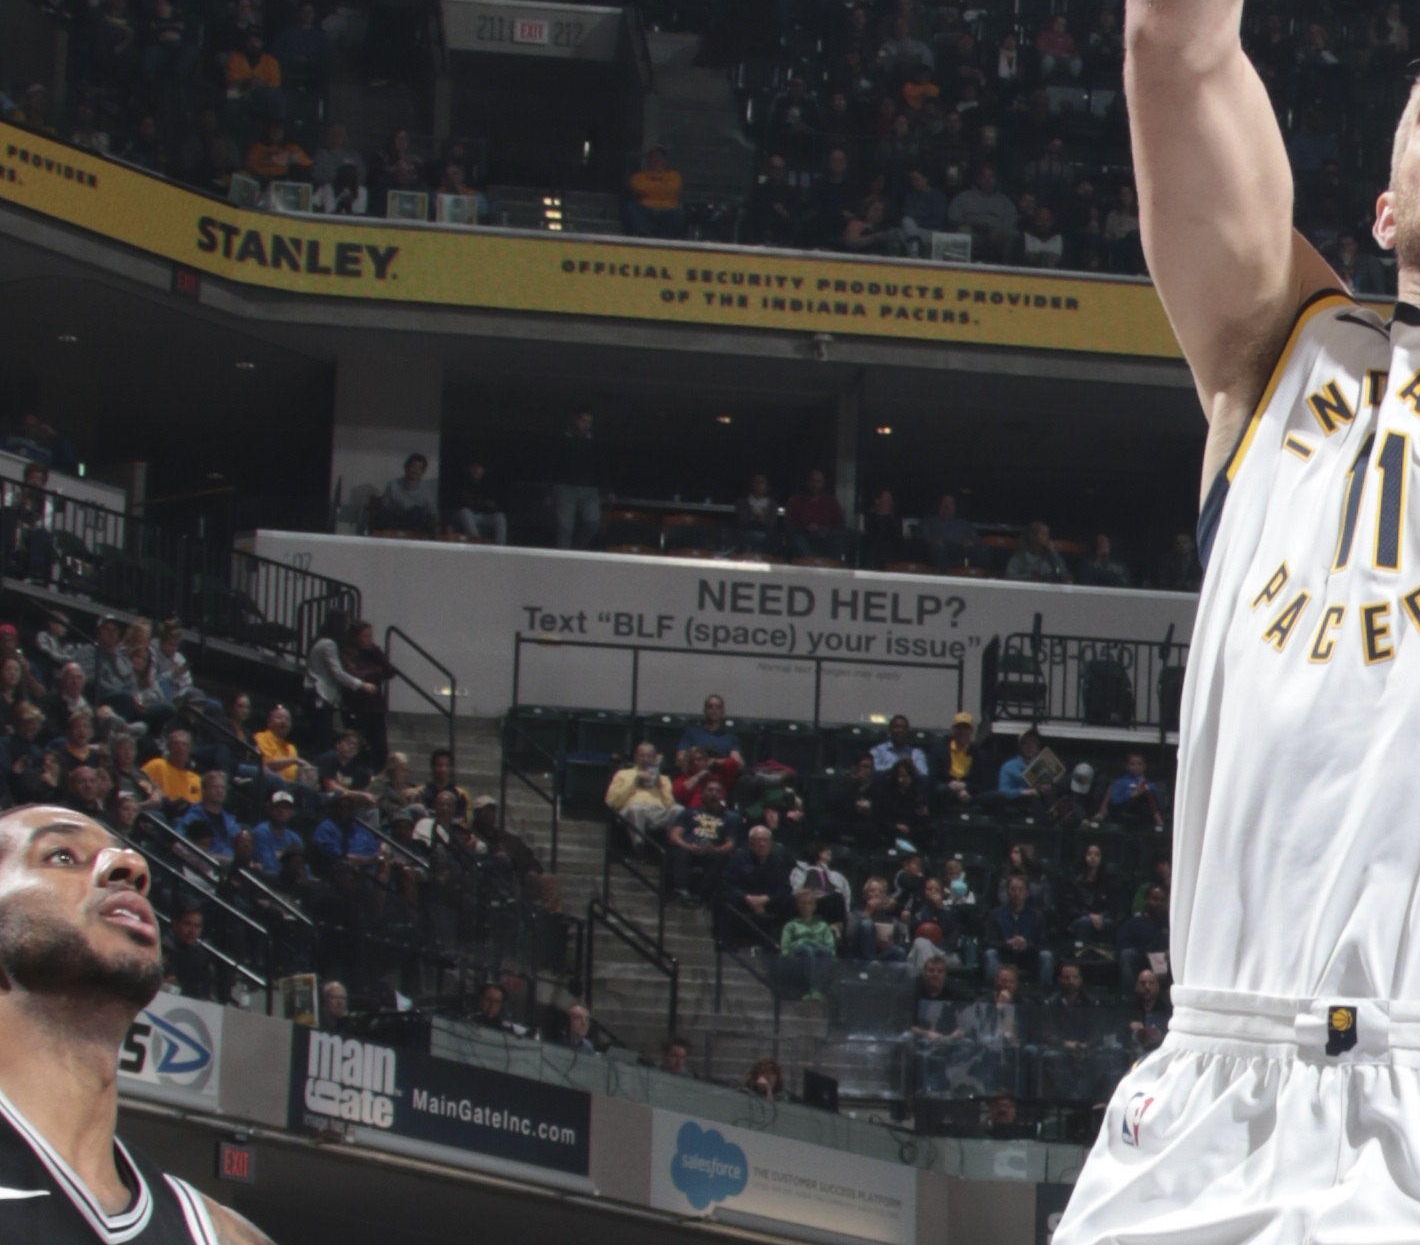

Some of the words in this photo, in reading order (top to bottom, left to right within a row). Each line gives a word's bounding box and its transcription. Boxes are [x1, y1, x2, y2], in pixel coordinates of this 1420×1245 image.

[476, 14, 505, 43] 211
[519, 20, 544, 40] EXIT
[553, 21, 584, 48] 212
[7, 143, 98, 190] PROVIDER
[561, 259, 673, 280] OFFICIAL
[685, 267, 804, 290] SECURITY
[816, 278, 945, 301] PRODUCTS
[957, 288, 1079, 310] PROVIDER
[660, 288, 690, 304] OF
[703, 291, 748, 308] THE
[762, 296, 867, 317] INDIANA
[1331, 428, 1410, 574] 11
[697, 578, 816, 619] NEED
[830, 588, 967, 629] HELP?
[523, 605, 588, 635] Text
[684, 617, 797, 654] (space)
[807, 632, 878, 656] your
[308, 1029, 397, 1096] main
[412, 1087, 577, 1147] MainGateInc.com
[223, 1145, 250, 1178] EXIT
[681, 1153, 742, 1180] salesforce
[752, 1165, 769, 1180] THE
[770, 1170, 818, 1190] CUSTOMER
[819, 1180, 856, 1200] SUCCESS
